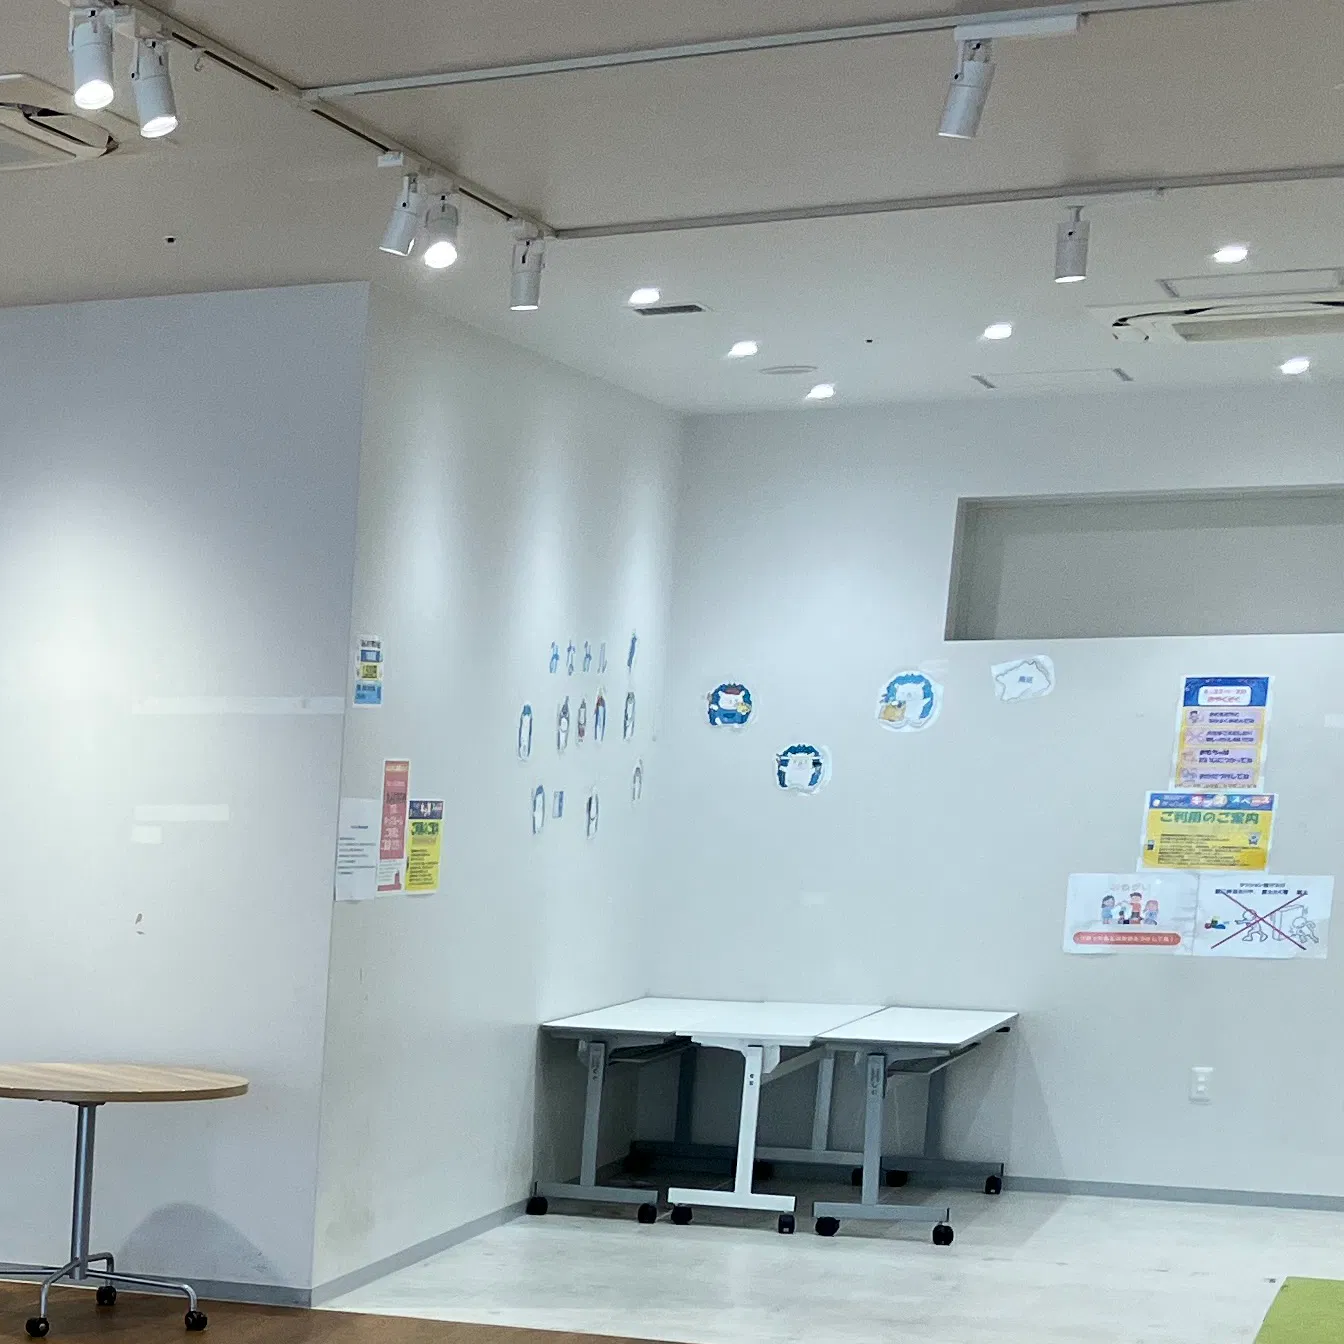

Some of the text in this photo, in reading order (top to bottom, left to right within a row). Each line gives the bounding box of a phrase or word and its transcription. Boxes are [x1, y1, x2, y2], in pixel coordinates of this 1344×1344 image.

[1160, 811, 1260, 824] ご利用のご案内
